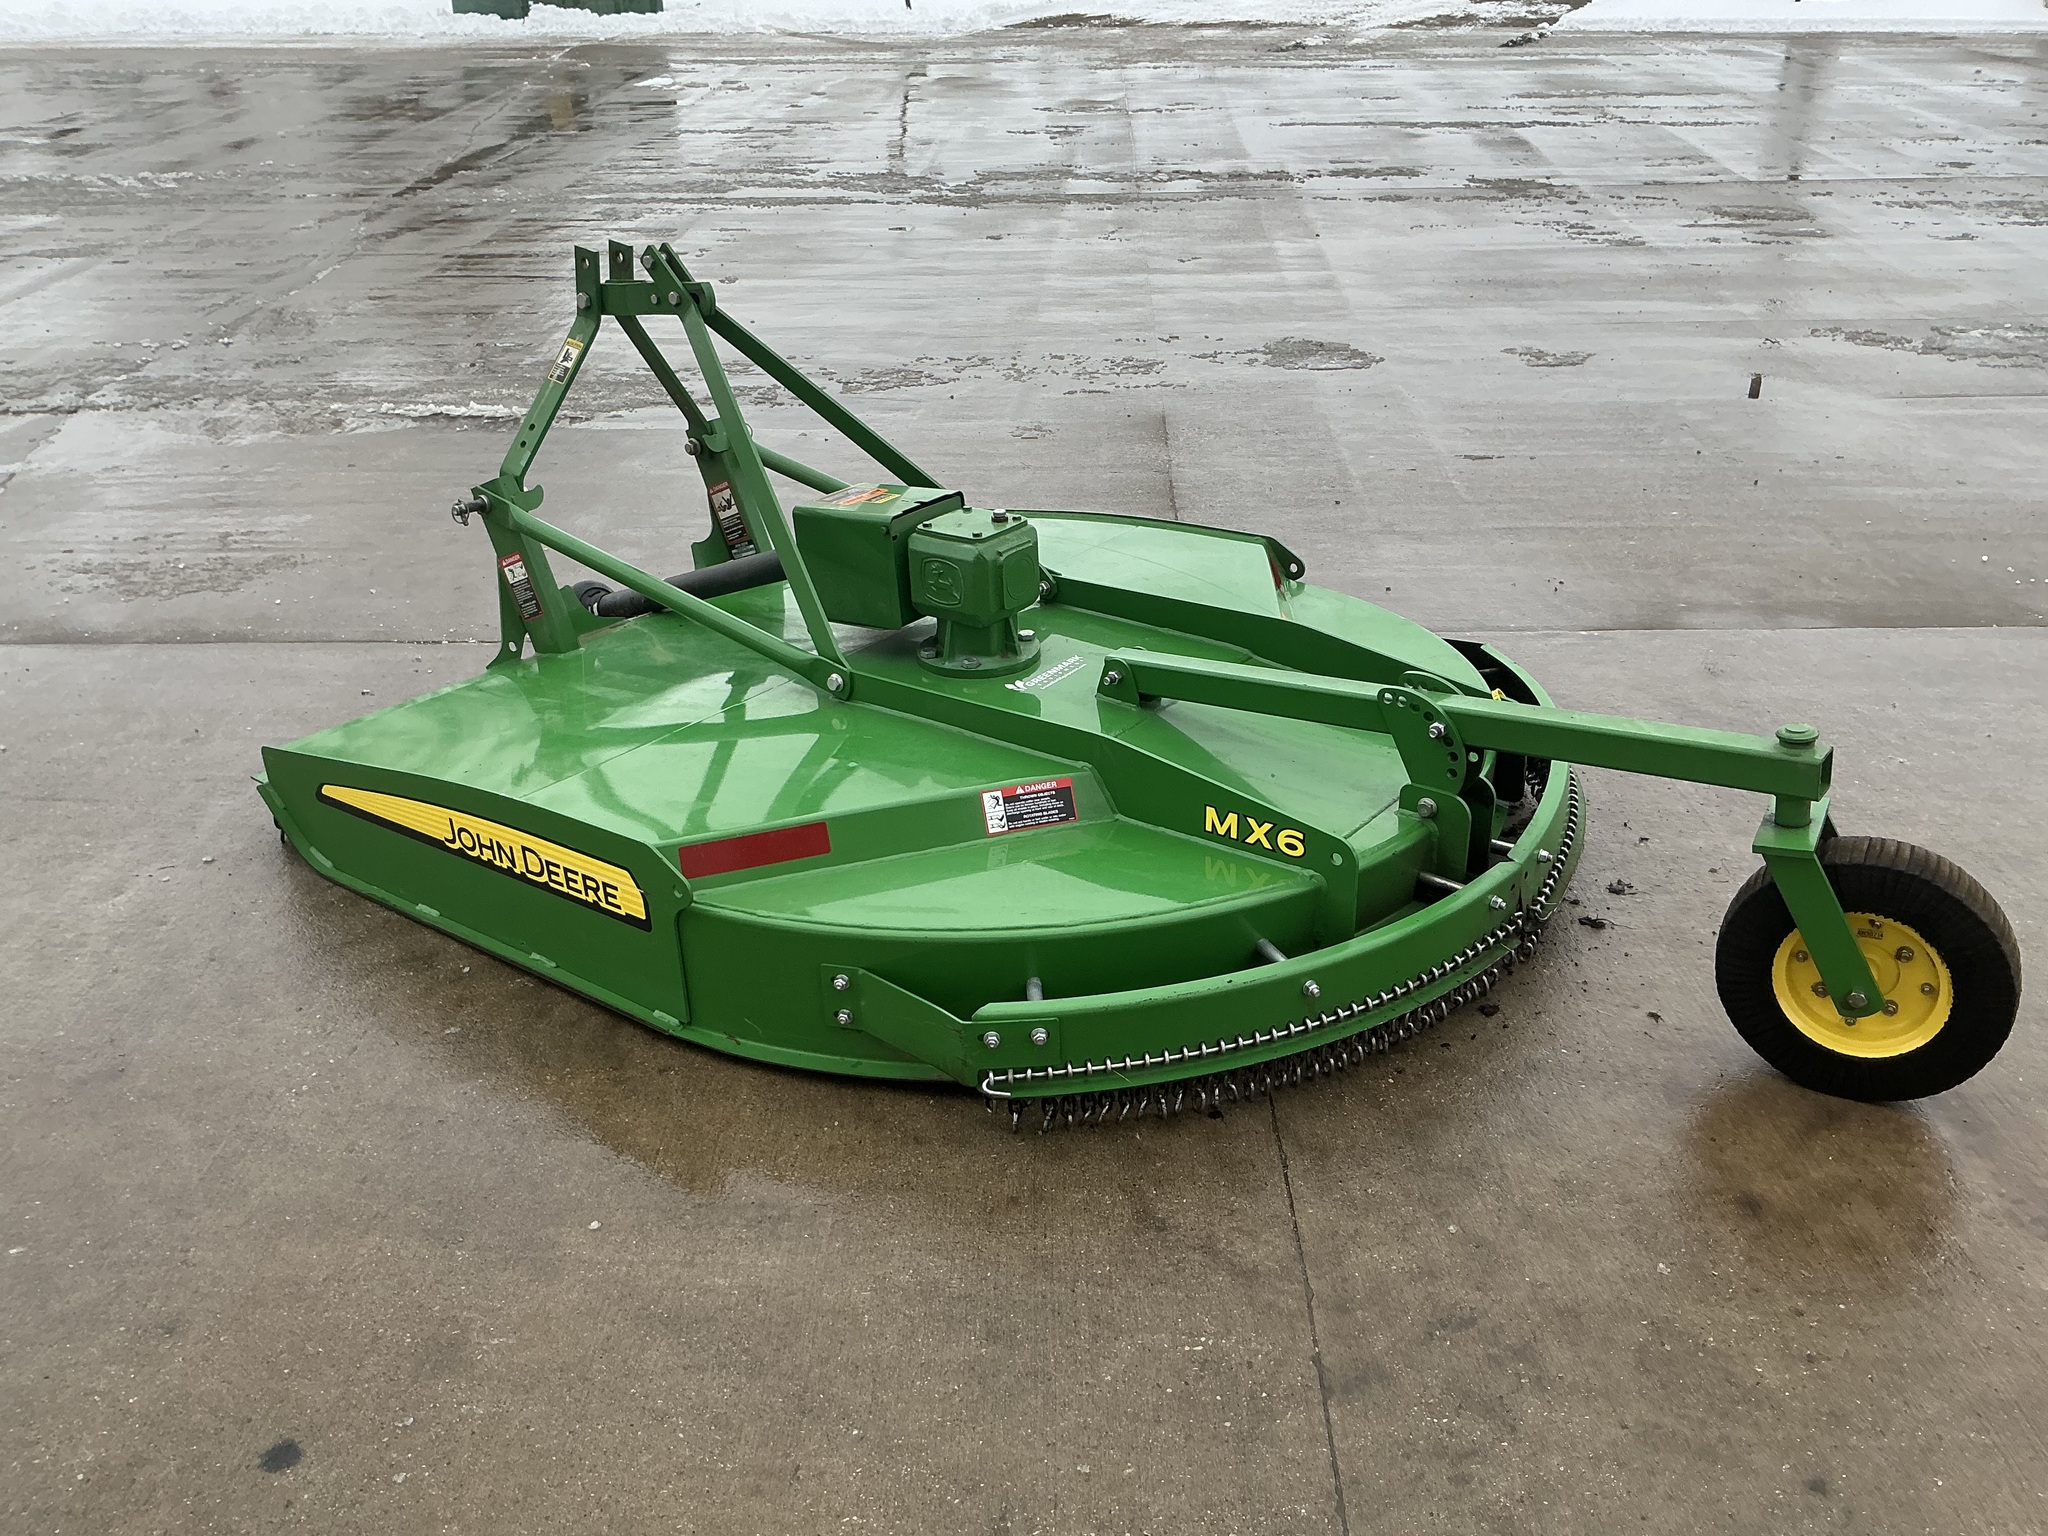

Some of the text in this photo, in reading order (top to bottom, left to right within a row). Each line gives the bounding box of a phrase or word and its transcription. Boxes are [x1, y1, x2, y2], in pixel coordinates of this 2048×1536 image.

[1024, 780, 1058, 793] DANGER
[1203, 803, 1307, 859] MX6
[443, 817, 624, 912] JOHN DEERE
